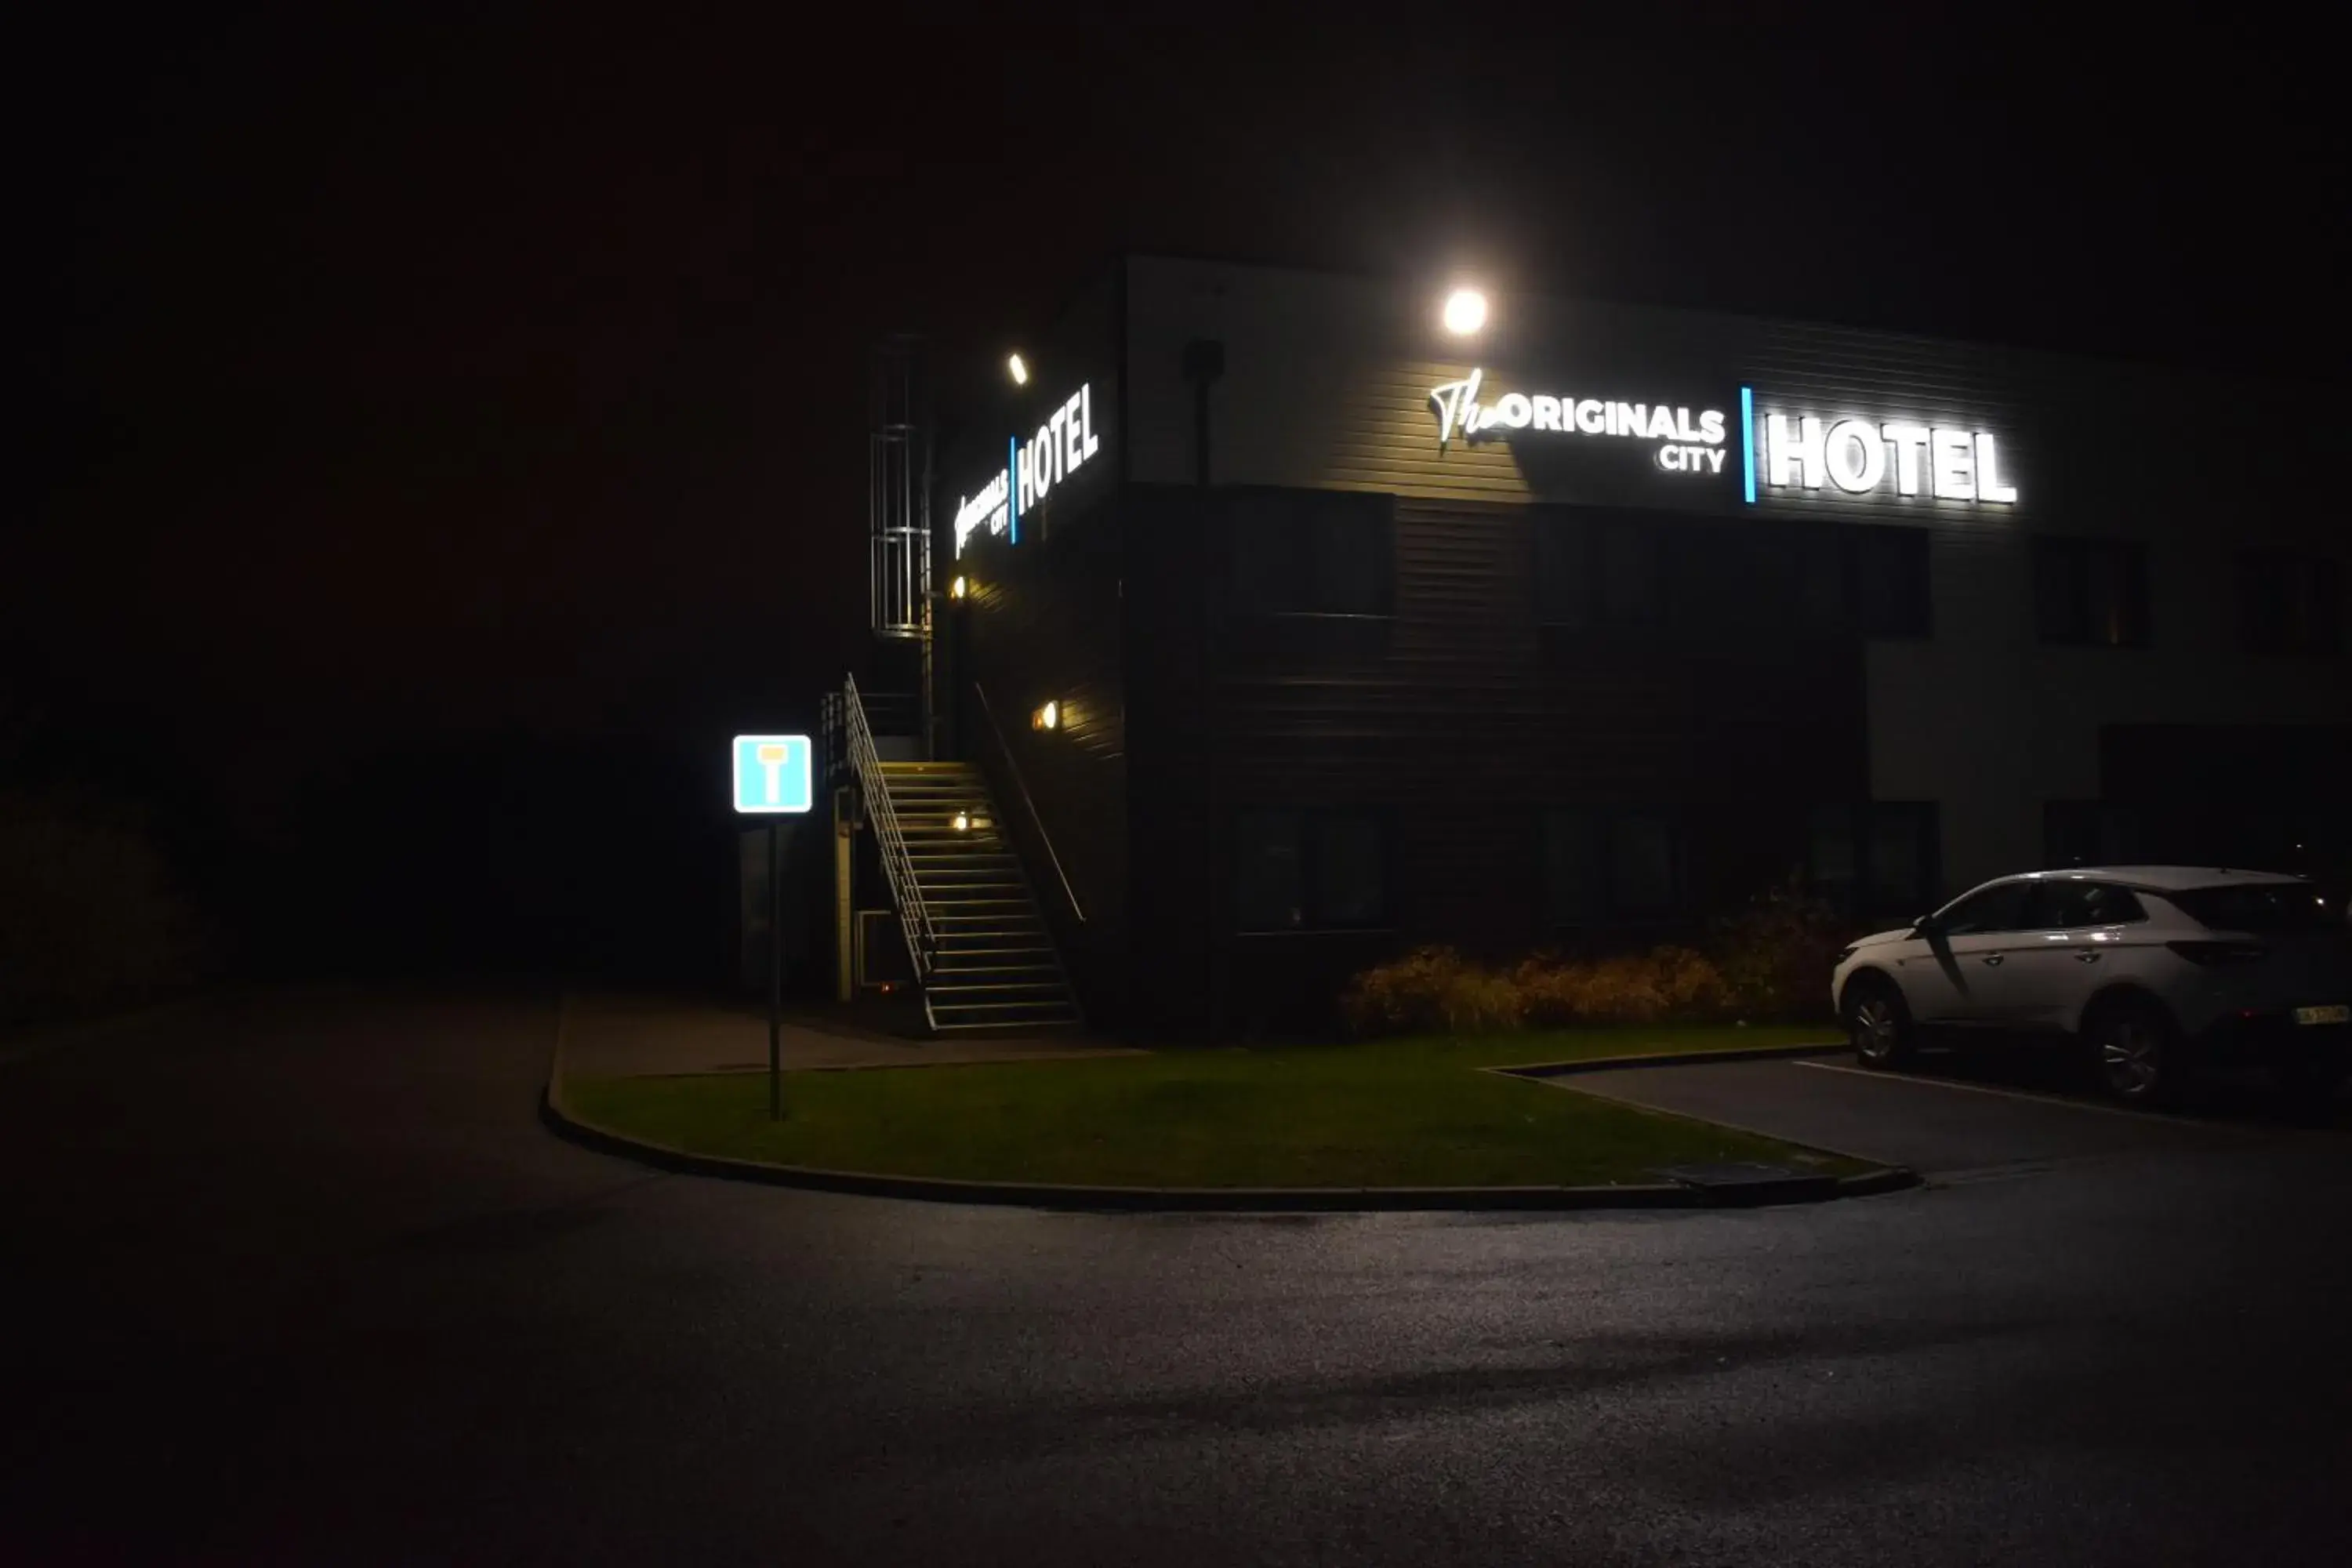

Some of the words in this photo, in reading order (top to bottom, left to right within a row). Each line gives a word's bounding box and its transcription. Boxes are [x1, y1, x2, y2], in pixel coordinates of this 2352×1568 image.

[1430, 368, 1501, 445] The
[1497, 393, 1726, 445] ORIGINALS
[1017, 383, 1099, 516] HOTEL
[1658, 444, 1726, 474] CITY
[1766, 412, 2017, 503] HOTEL
